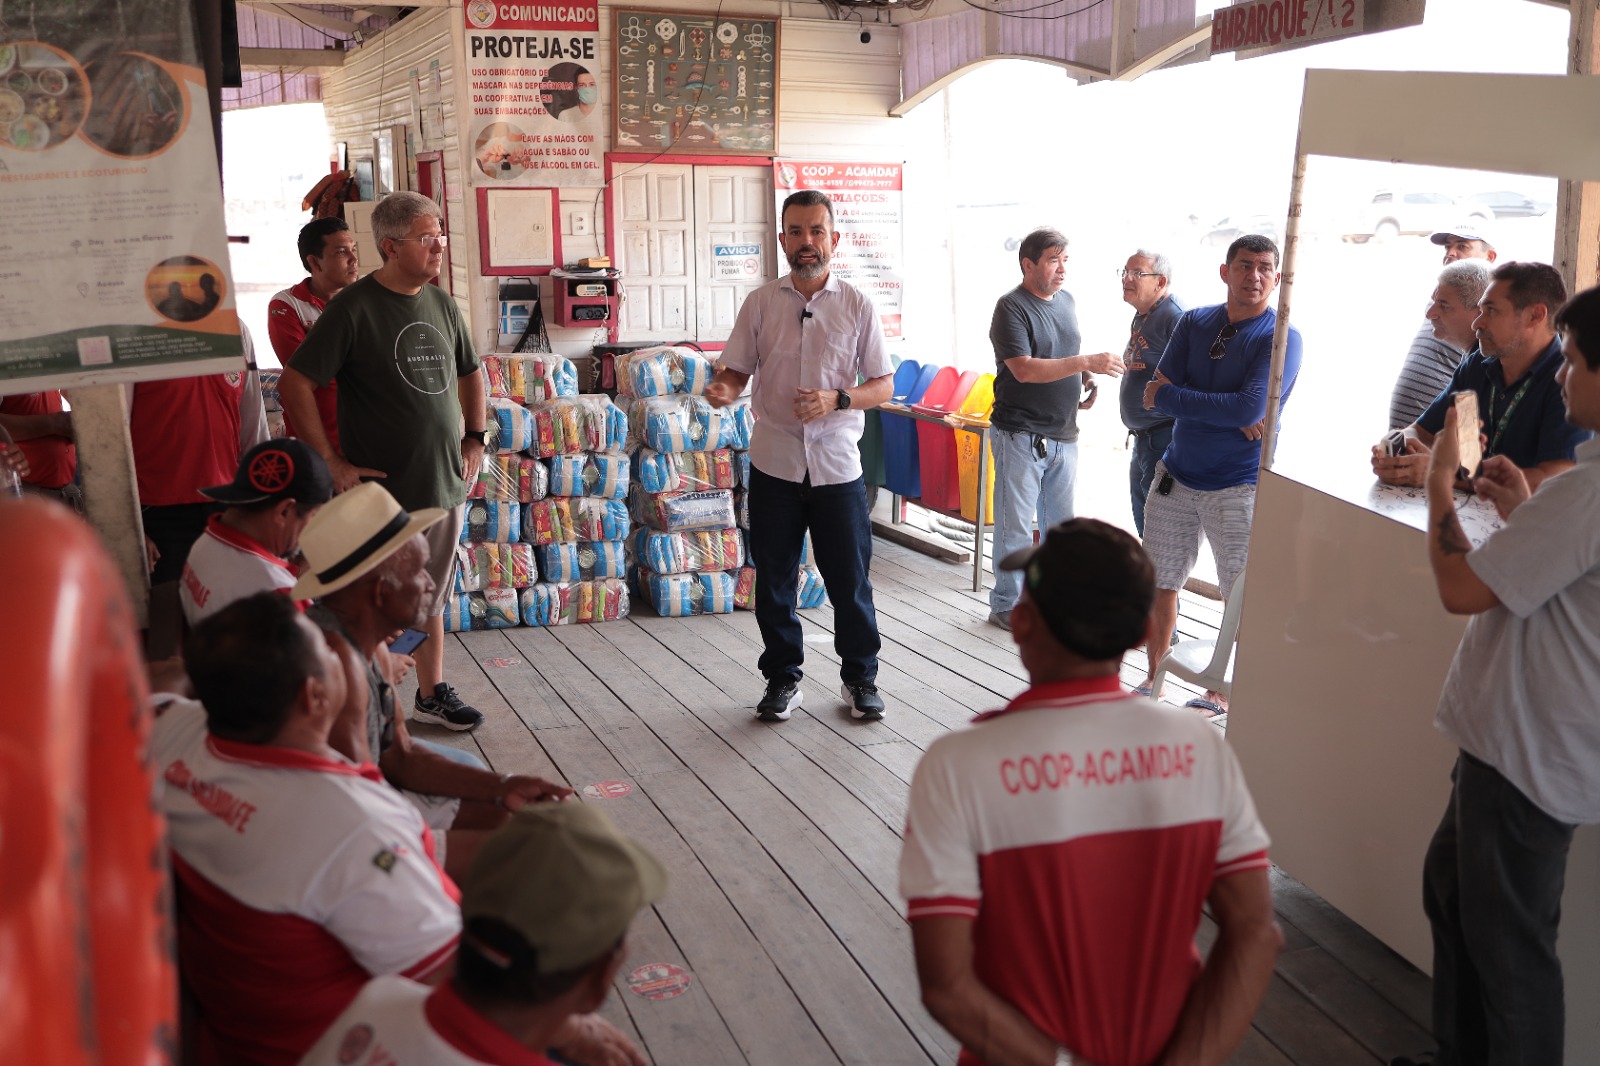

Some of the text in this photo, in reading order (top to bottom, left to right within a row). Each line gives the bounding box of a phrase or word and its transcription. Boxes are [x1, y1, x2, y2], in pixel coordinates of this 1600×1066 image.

[499, 5, 596, 23] COMUNICADO
[471, 36, 595, 59] PROTEJA-SE
[472, 67, 549, 77] USO OBRIGATÓRIO DE
[472, 80, 507, 90] MÁSCARA
[509, 82, 523, 90] NAS
[485, 95, 533, 103] COOPERATIVA
[541, 95, 552, 103] EM
[522, 134, 594, 143] LAVE AS MÃOS COM
[552, 147, 576, 156] SABÃO
[524, 160, 600, 169] USE ÁLCOOL EM GEL.
[802, 166, 835, 176] COOP
[845, 167, 899, 177] ACAMDAF
[719, 246, 757, 255] AVISO
[407, 354, 446, 362] AUSTRALIA
[1000, 744, 1196, 796] COOP-ACAMDAF
